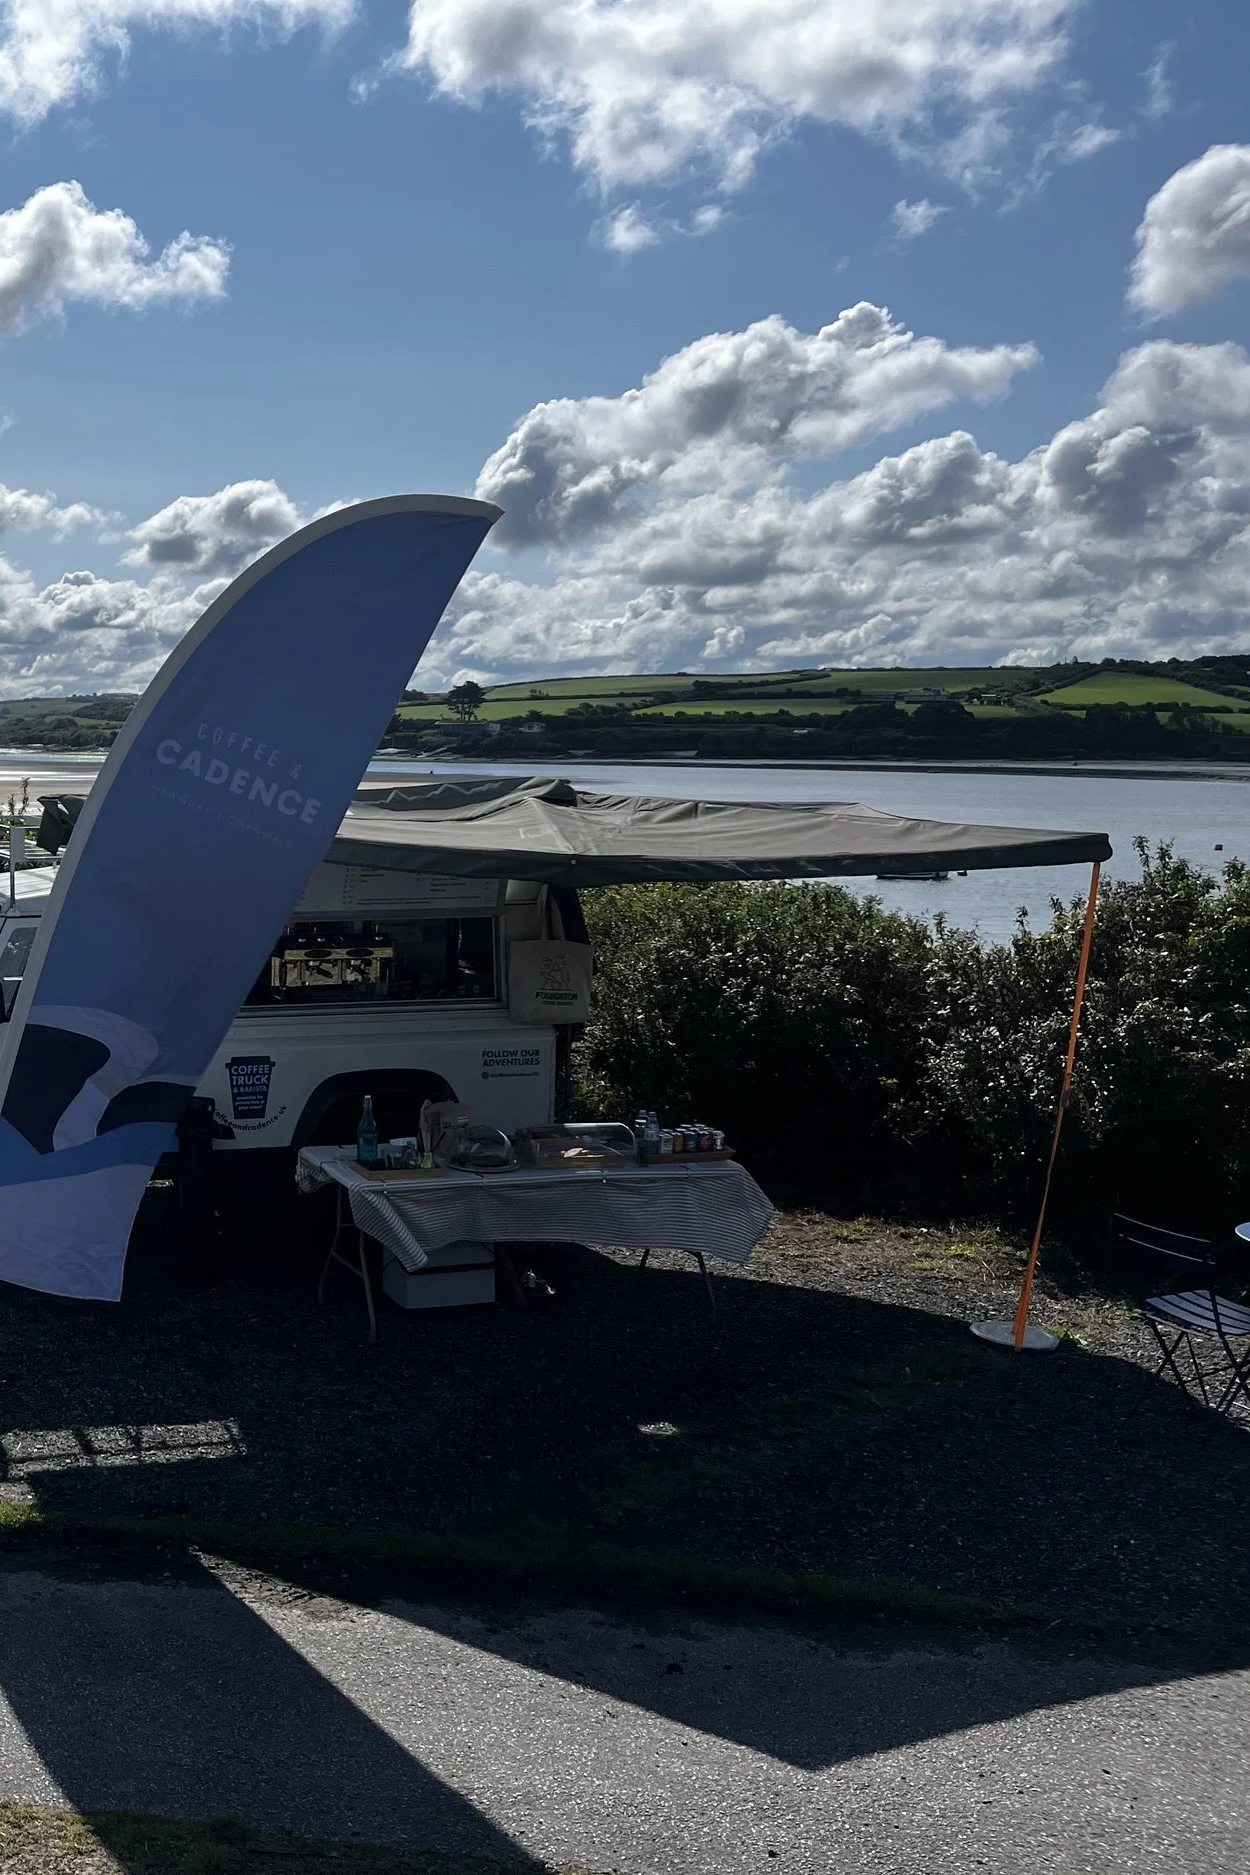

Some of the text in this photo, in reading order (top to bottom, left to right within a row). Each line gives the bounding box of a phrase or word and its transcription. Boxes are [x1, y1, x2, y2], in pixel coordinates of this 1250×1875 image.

[198, 723, 302, 780] COFFEE &
[156, 739, 321, 824] CADENCE
[481, 1049, 540, 1058] FOLLOW OUR
[482, 1058, 540, 1067] ADVENTURES
[231, 1065, 270, 1075] COFFEE
[231, 1075, 269, 1085] TRUCK
[239, 1085, 267, 1093] BARISTA
[214, 1105, 287, 1131] offeeandcadence.uk
